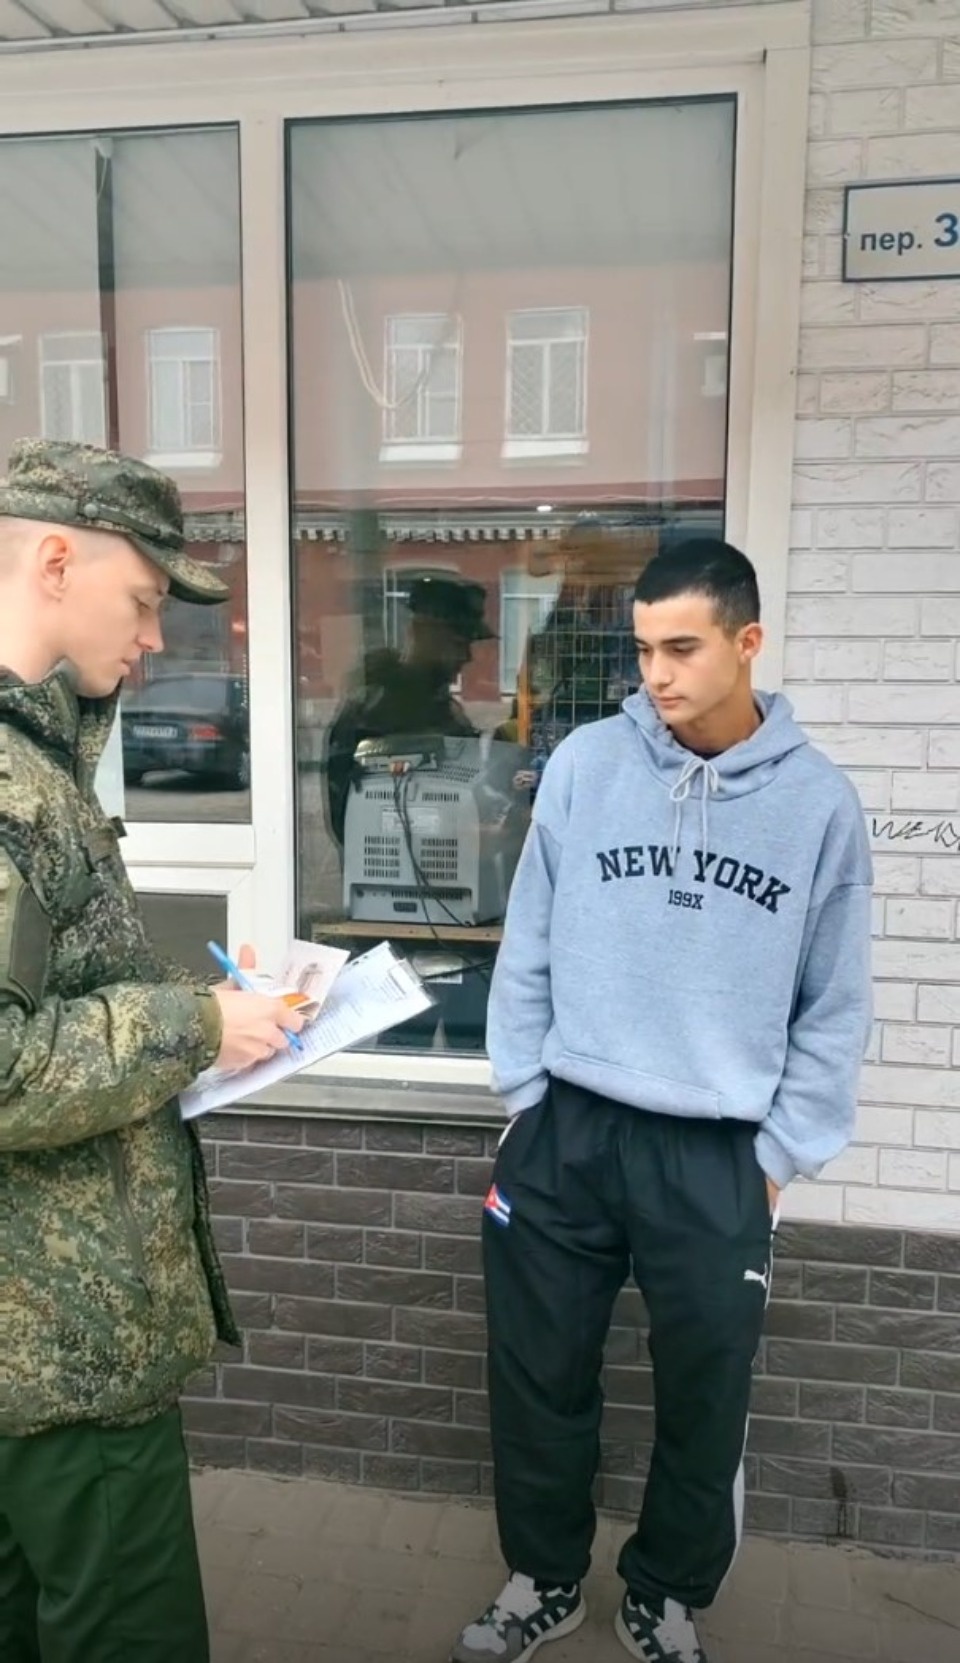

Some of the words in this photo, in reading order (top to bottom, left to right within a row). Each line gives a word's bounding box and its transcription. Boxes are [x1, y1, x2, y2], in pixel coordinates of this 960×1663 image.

[860, 231, 923, 256] пер.
[596, 845, 681, 883] NEW
[693, 849, 791, 914] YORK
[667, 889, 705, 910] 199X
